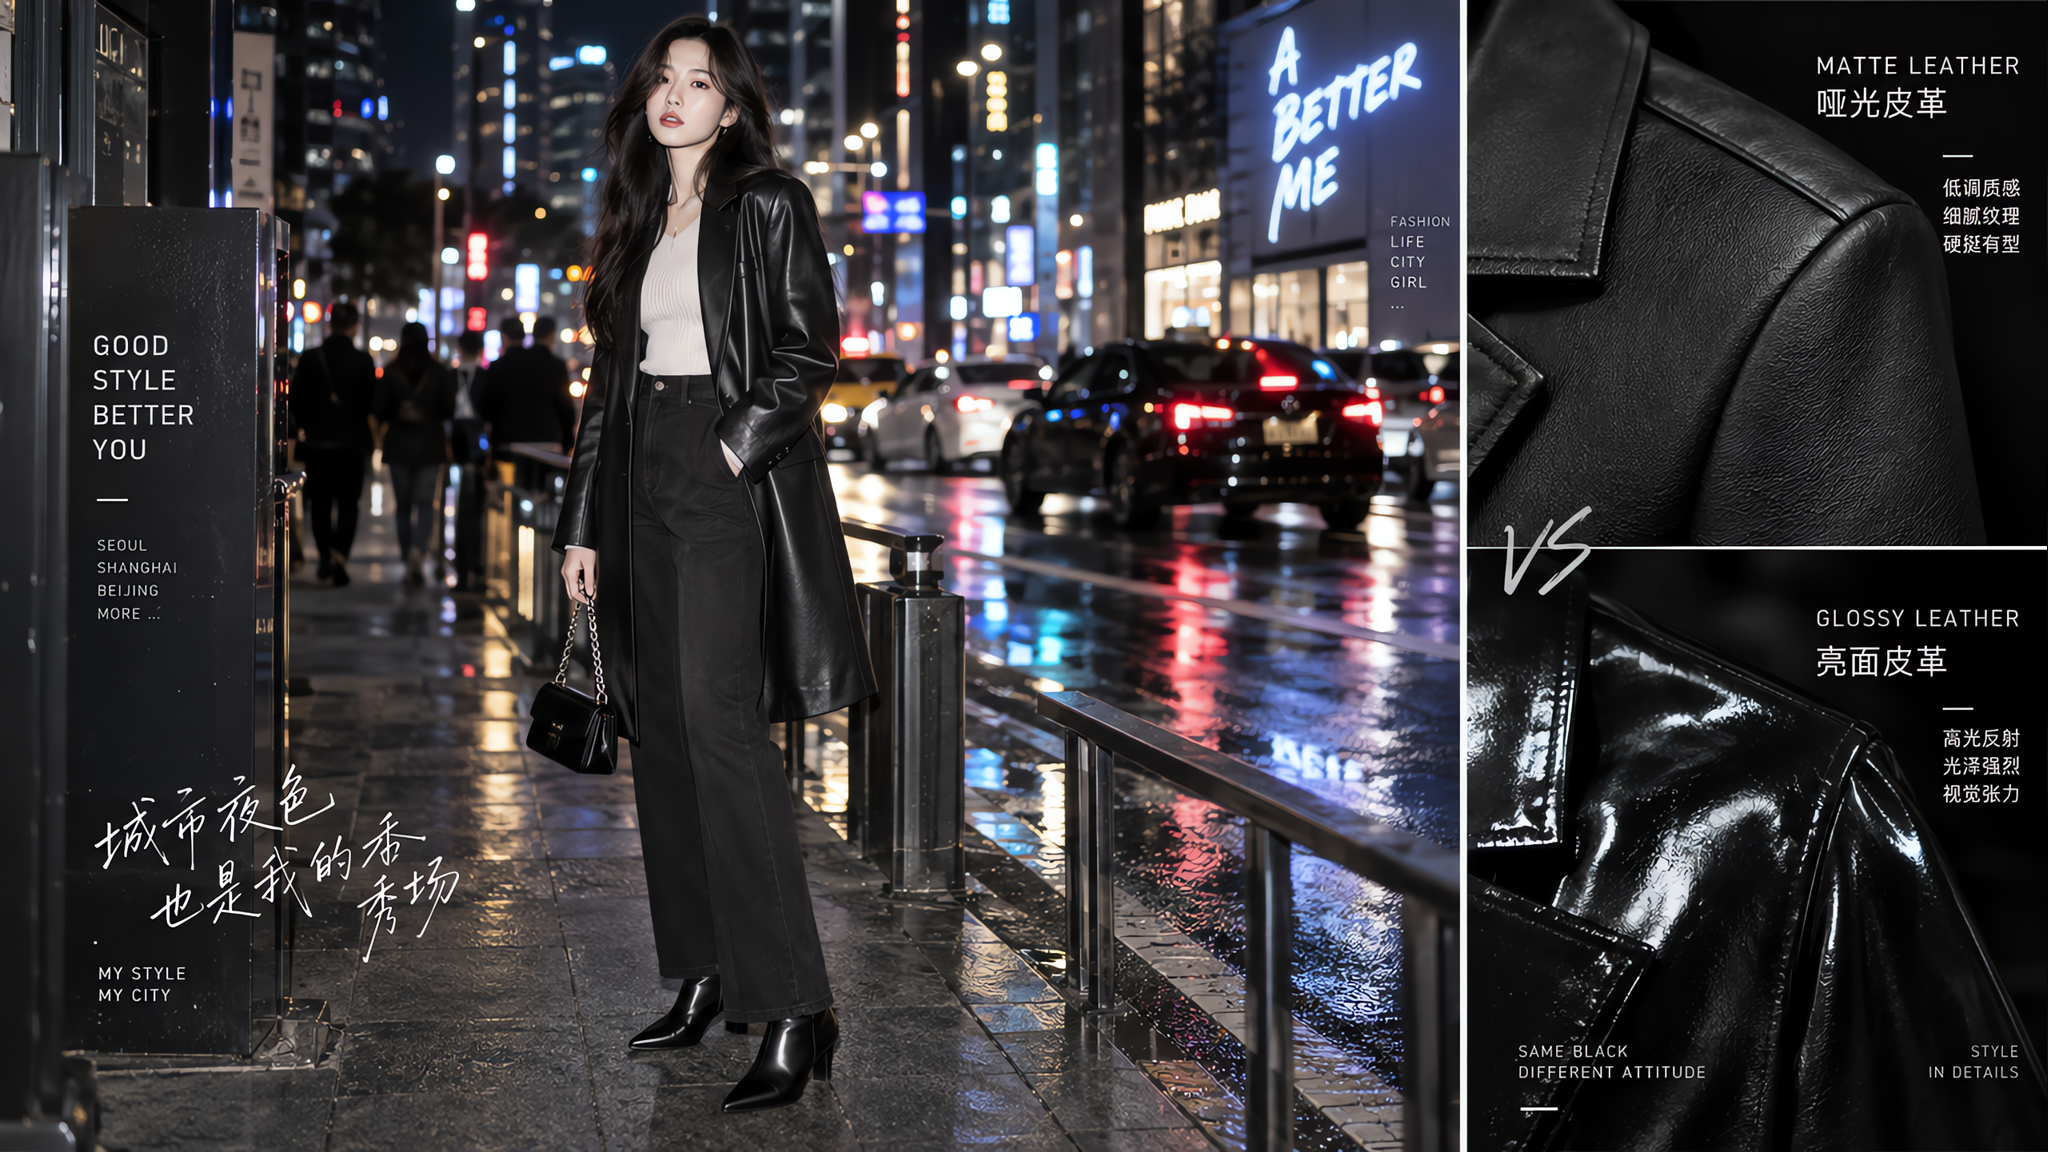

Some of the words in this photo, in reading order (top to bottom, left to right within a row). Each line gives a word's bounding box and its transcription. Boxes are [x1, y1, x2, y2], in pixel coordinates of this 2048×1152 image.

[1268, 26, 1301, 97] A
[1271, 42, 1422, 164] BETTER
[1268, 145, 1340, 244] ME
